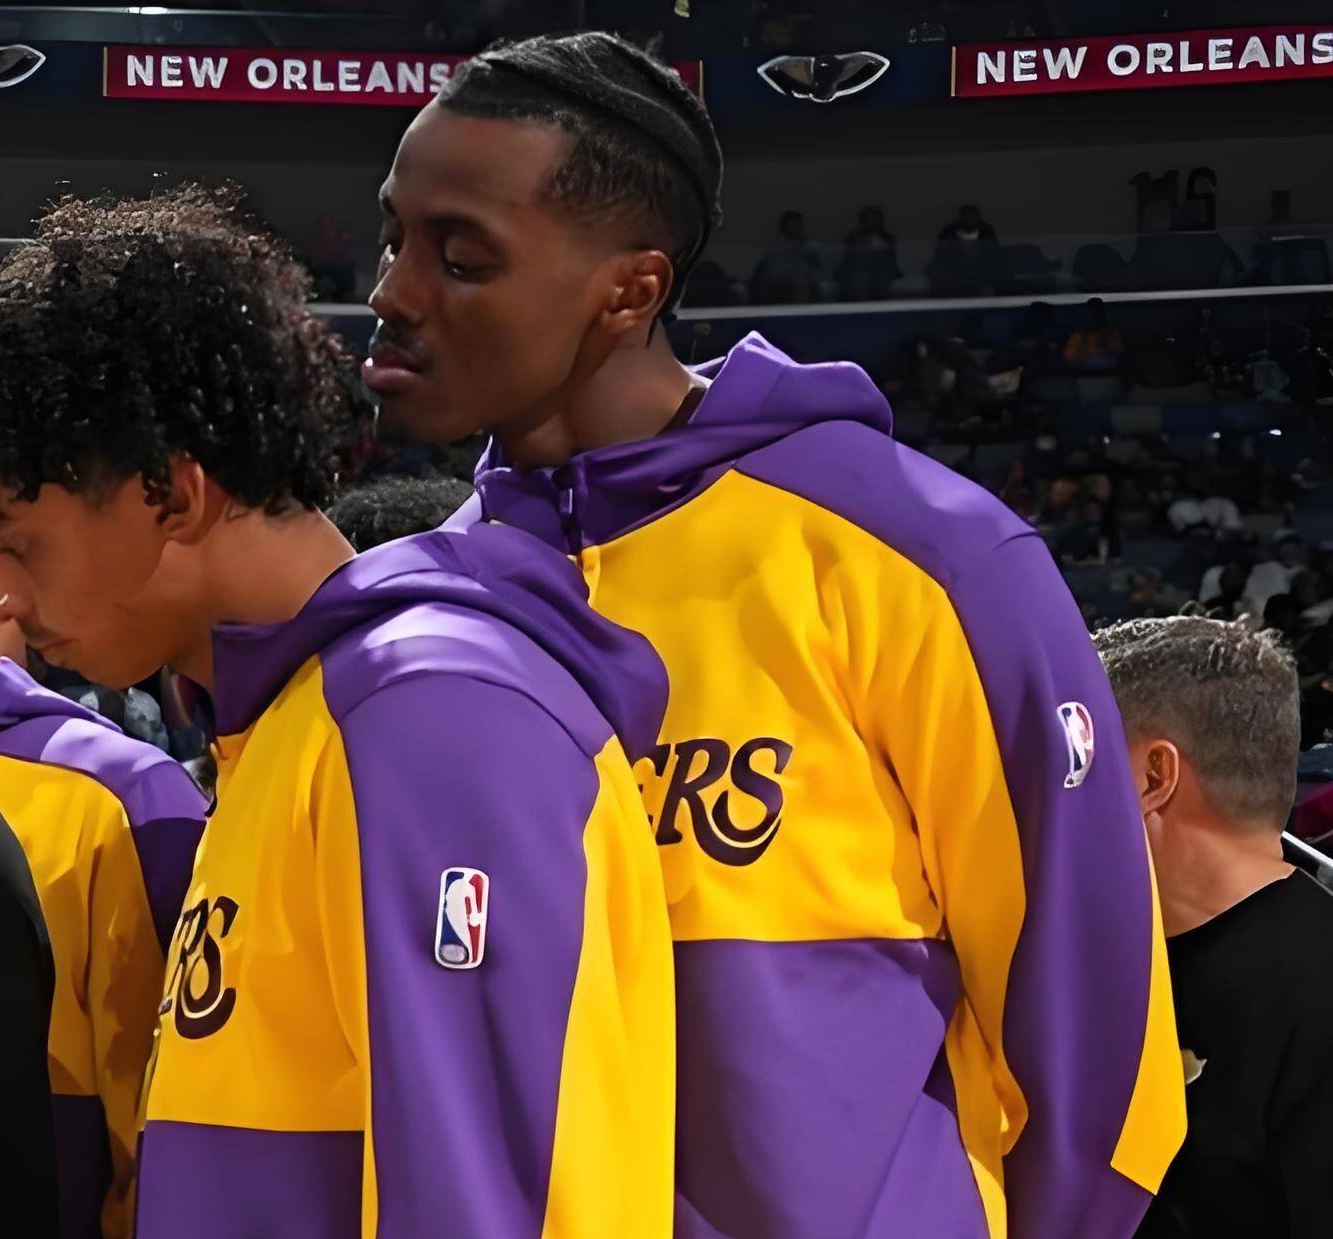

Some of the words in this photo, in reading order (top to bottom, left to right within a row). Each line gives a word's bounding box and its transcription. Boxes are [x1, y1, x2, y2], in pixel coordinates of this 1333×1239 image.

[127, 54, 229, 88] NEW
[976, 46, 1088, 85] NEW
[1106, 33, 1333, 76] ORLEANS
